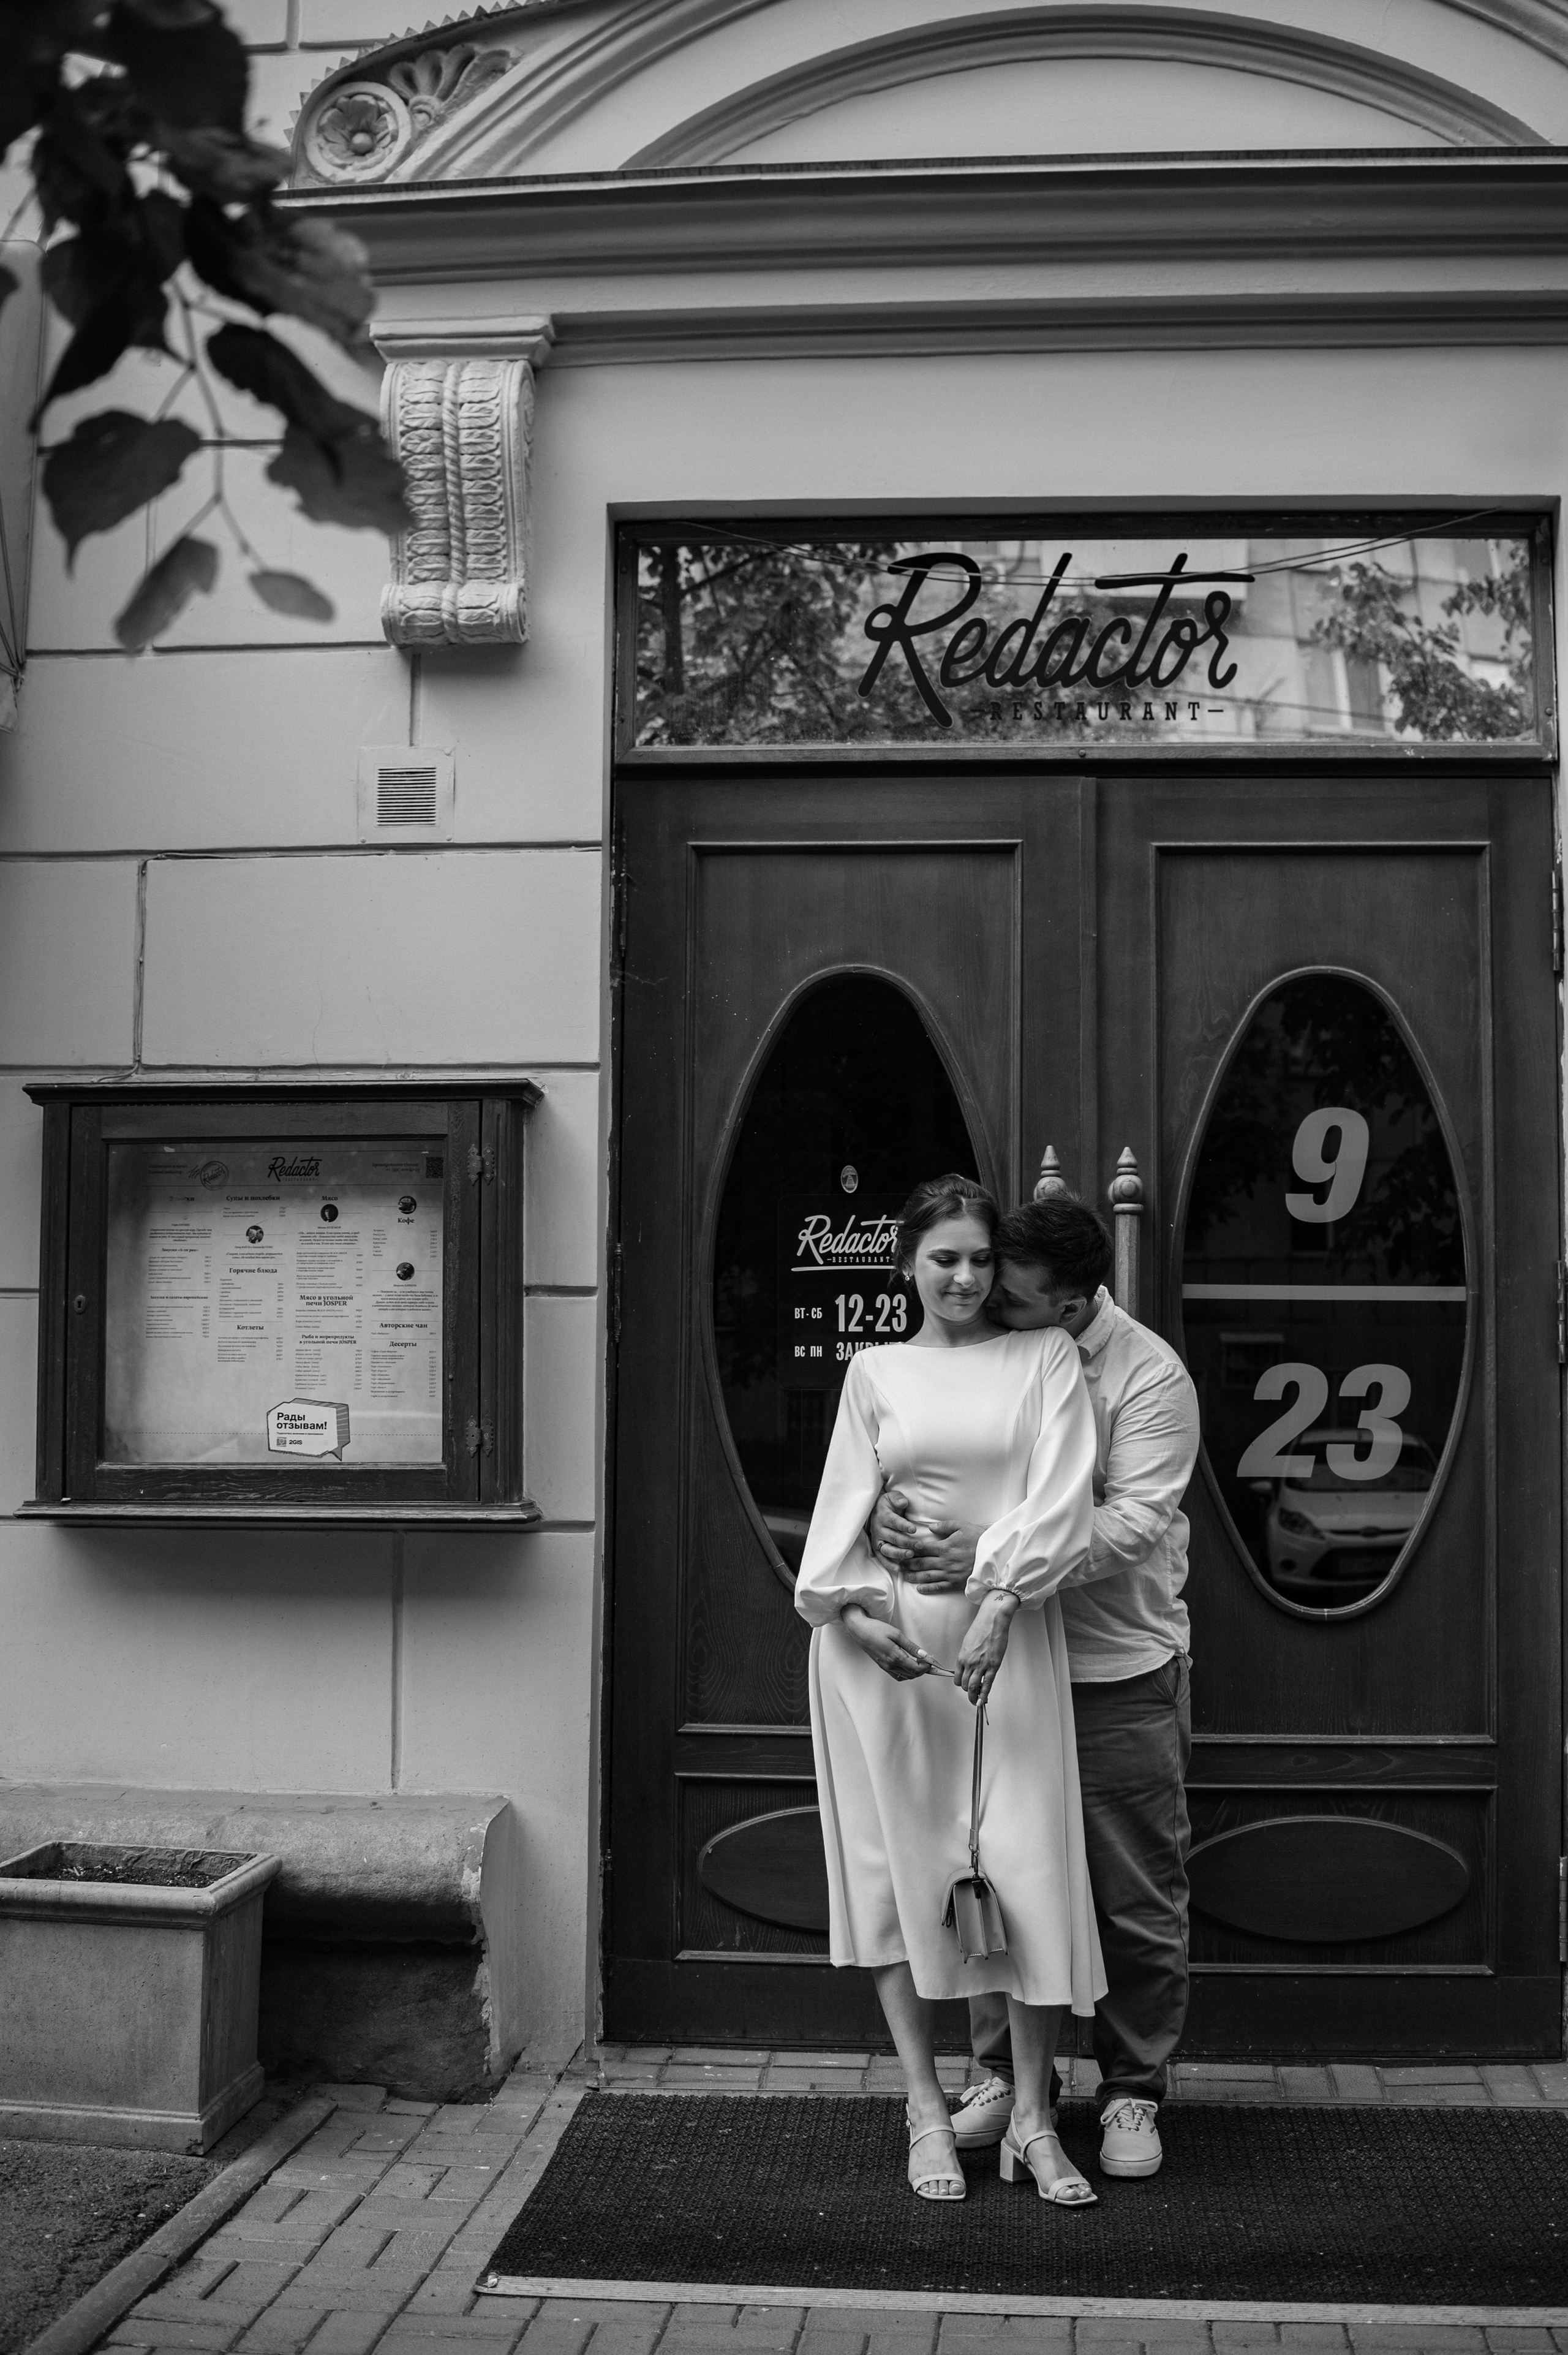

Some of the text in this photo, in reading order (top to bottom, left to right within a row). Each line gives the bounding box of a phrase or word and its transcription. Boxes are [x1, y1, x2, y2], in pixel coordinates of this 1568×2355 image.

[858, 552, 1255, 729] Redactor
[991, 701, 1200, 721] RESTAURANT
[268, 1156, 323, 1182] Redactor
[1285, 1106, 1370, 1223] 9
[797, 1214, 904, 1264] Redactor
[835, 1294, 907, 1332] 12-23
[794, 1346, 822, 1357] ВС ПН
[277, 1412, 305, 1422] Рады
[1237, 1362, 1411, 1480] 23
